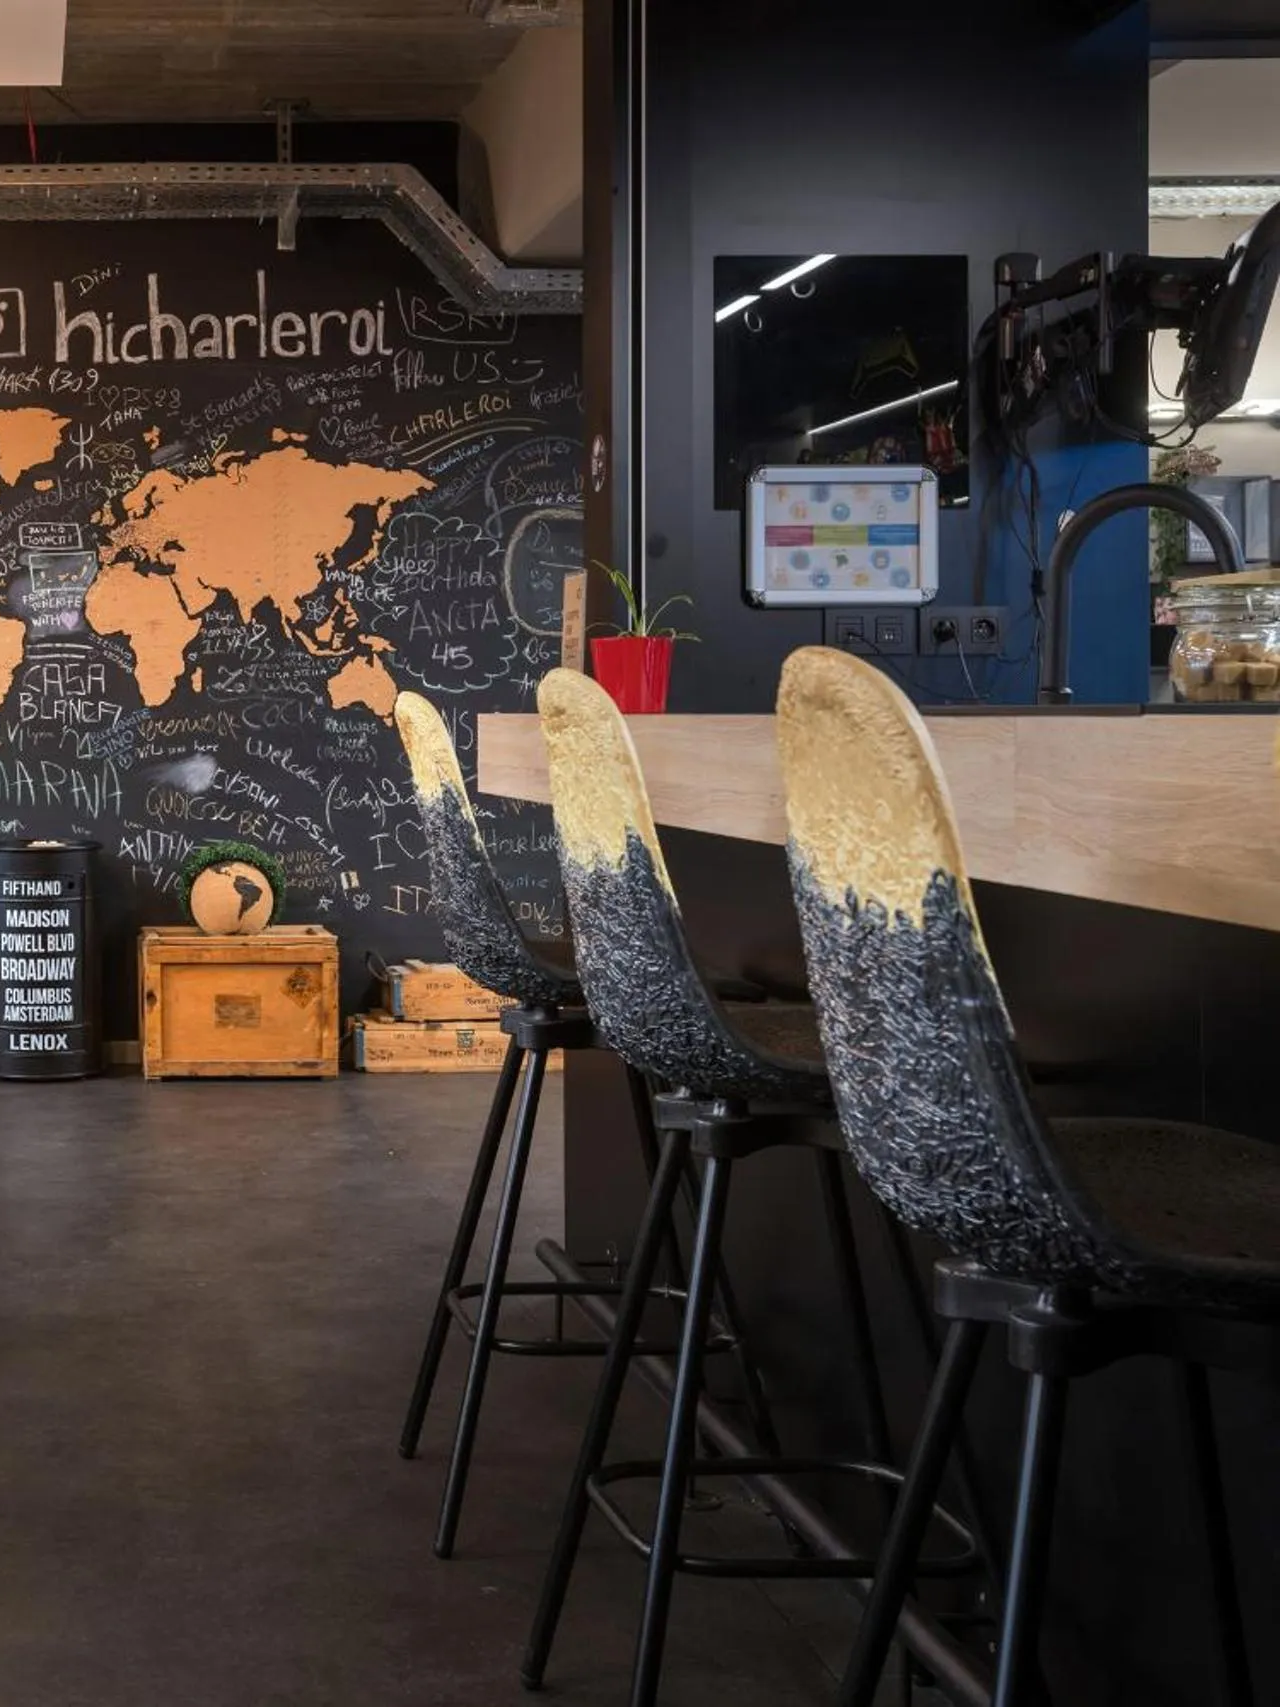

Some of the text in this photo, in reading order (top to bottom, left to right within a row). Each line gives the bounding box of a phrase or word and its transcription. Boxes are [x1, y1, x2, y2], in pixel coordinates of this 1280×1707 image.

[53, 269, 394, 365] hicharleroi
[23, 663, 105, 698] CASA
[3, 880, 61, 896] FIFTHAND
[6, 909, 70, 928] MADISON
[1, 933, 75, 952] POWELL BLVD
[1, 957, 76, 981] BROADWAY
[5, 987, 72, 1004] COLUMBUS
[4, 1005, 73, 1022] AMSTERDAM
[10, 1033, 68, 1051] LENOX
